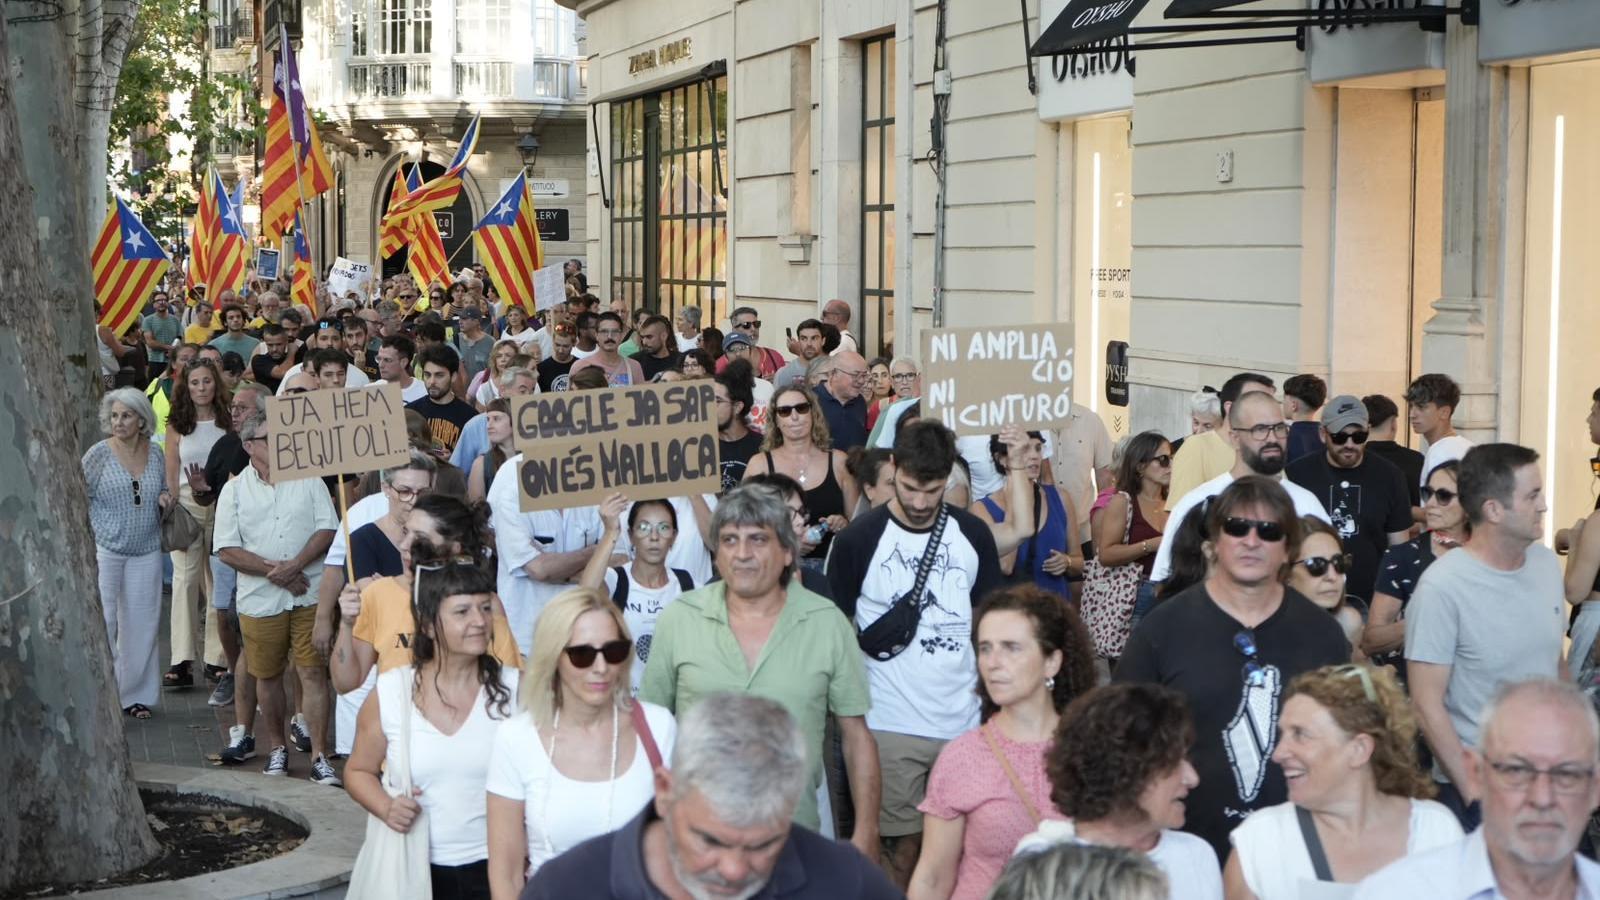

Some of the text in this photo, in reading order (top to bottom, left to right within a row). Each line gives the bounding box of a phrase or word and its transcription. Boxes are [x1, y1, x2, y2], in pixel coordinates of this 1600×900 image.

[1072, 0, 1133, 29] OYSHO
[1108, 268, 1131, 281] SPORT
[931, 330, 1058, 363] NI AMPLIA
[1031, 347, 1073, 383] CIÓ
[278, 388, 392, 426] JA HEM
[517, 393, 619, 440] GOOGLE
[625, 389, 661, 427] JA
[663, 384, 715, 424] SAP
[929, 378, 955, 409] NI
[959, 387, 1070, 427] CINTURÓ
[276, 425, 345, 470] BEGUT
[599, 433, 716, 488] MALLOCA
